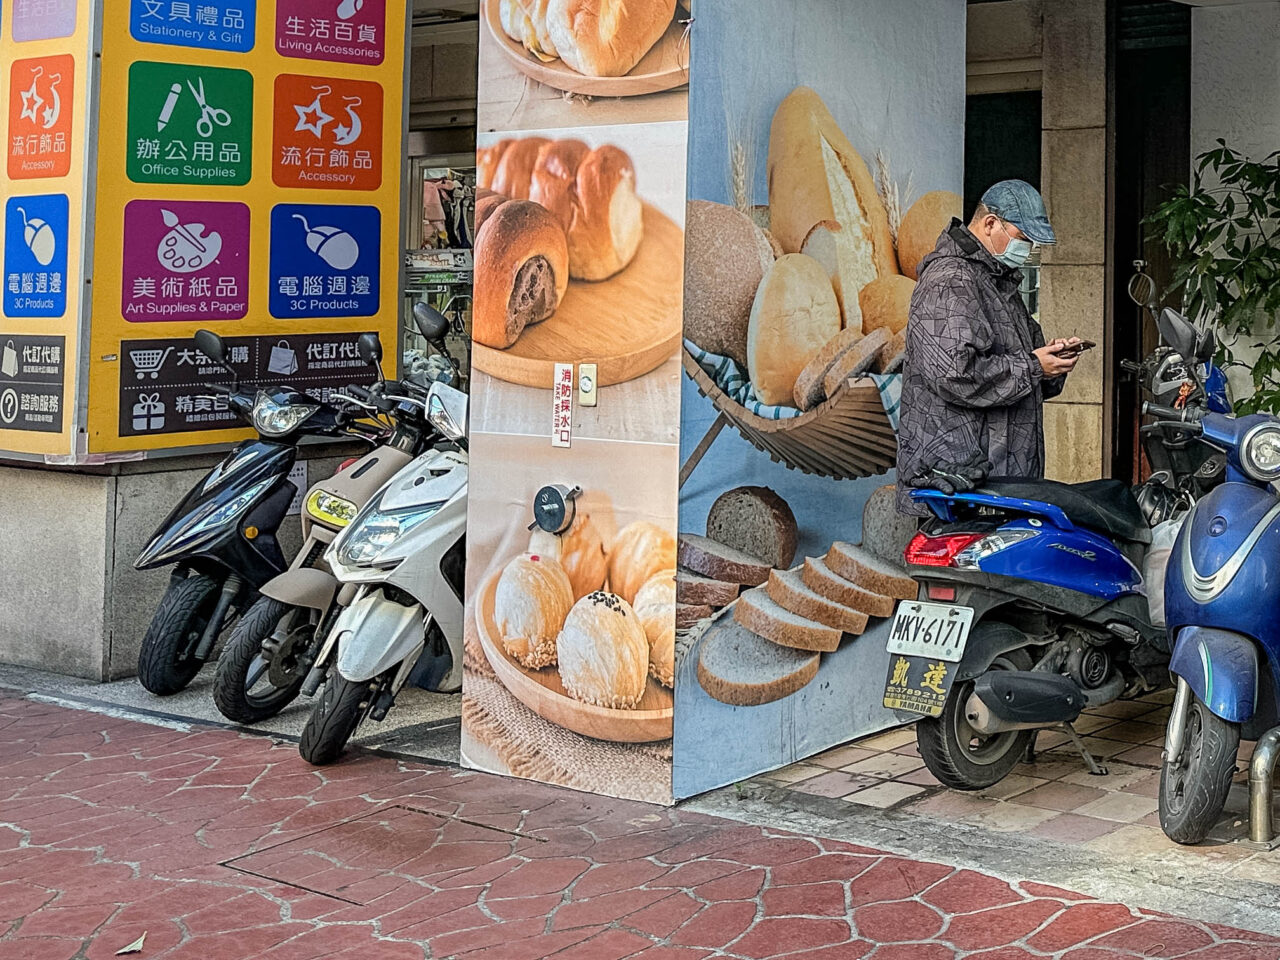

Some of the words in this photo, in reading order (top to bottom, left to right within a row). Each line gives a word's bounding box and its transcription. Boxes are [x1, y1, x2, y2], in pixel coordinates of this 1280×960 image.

[140, 22, 204, 41] Stationery
[208, 31, 217, 41] &
[221, 32, 242, 44] Gift
[285, 16, 377, 44] 生活百貨
[279, 38, 312, 53] Living
[314, 43, 381, 58] Accessories
[12, 132, 66, 156] 流行飾品
[137, 138, 241, 163] 辦公用品
[281, 146, 373, 169] 流行飾品
[141, 163, 179, 176] Office
[183, 165, 236, 178] Supplies
[298, 169, 356, 182] Accessory
[8, 272, 62, 294] 電腦週邊
[132, 277, 238, 298] 美術紙品
[278, 276, 371, 296] 電腦週邊
[14, 298, 24, 309] 3C
[25, 298, 54, 309] Products
[126, 302, 143, 313] Art
[146, 302, 197, 315] Supplies
[199, 302, 209, 313] &
[211, 302, 246, 315] Paper
[290, 300, 307, 310] 3C
[310, 300, 359, 310] Products
[891, 614, 965, 649] MKV-6171
[900, 700, 932, 714] YAMAHA
